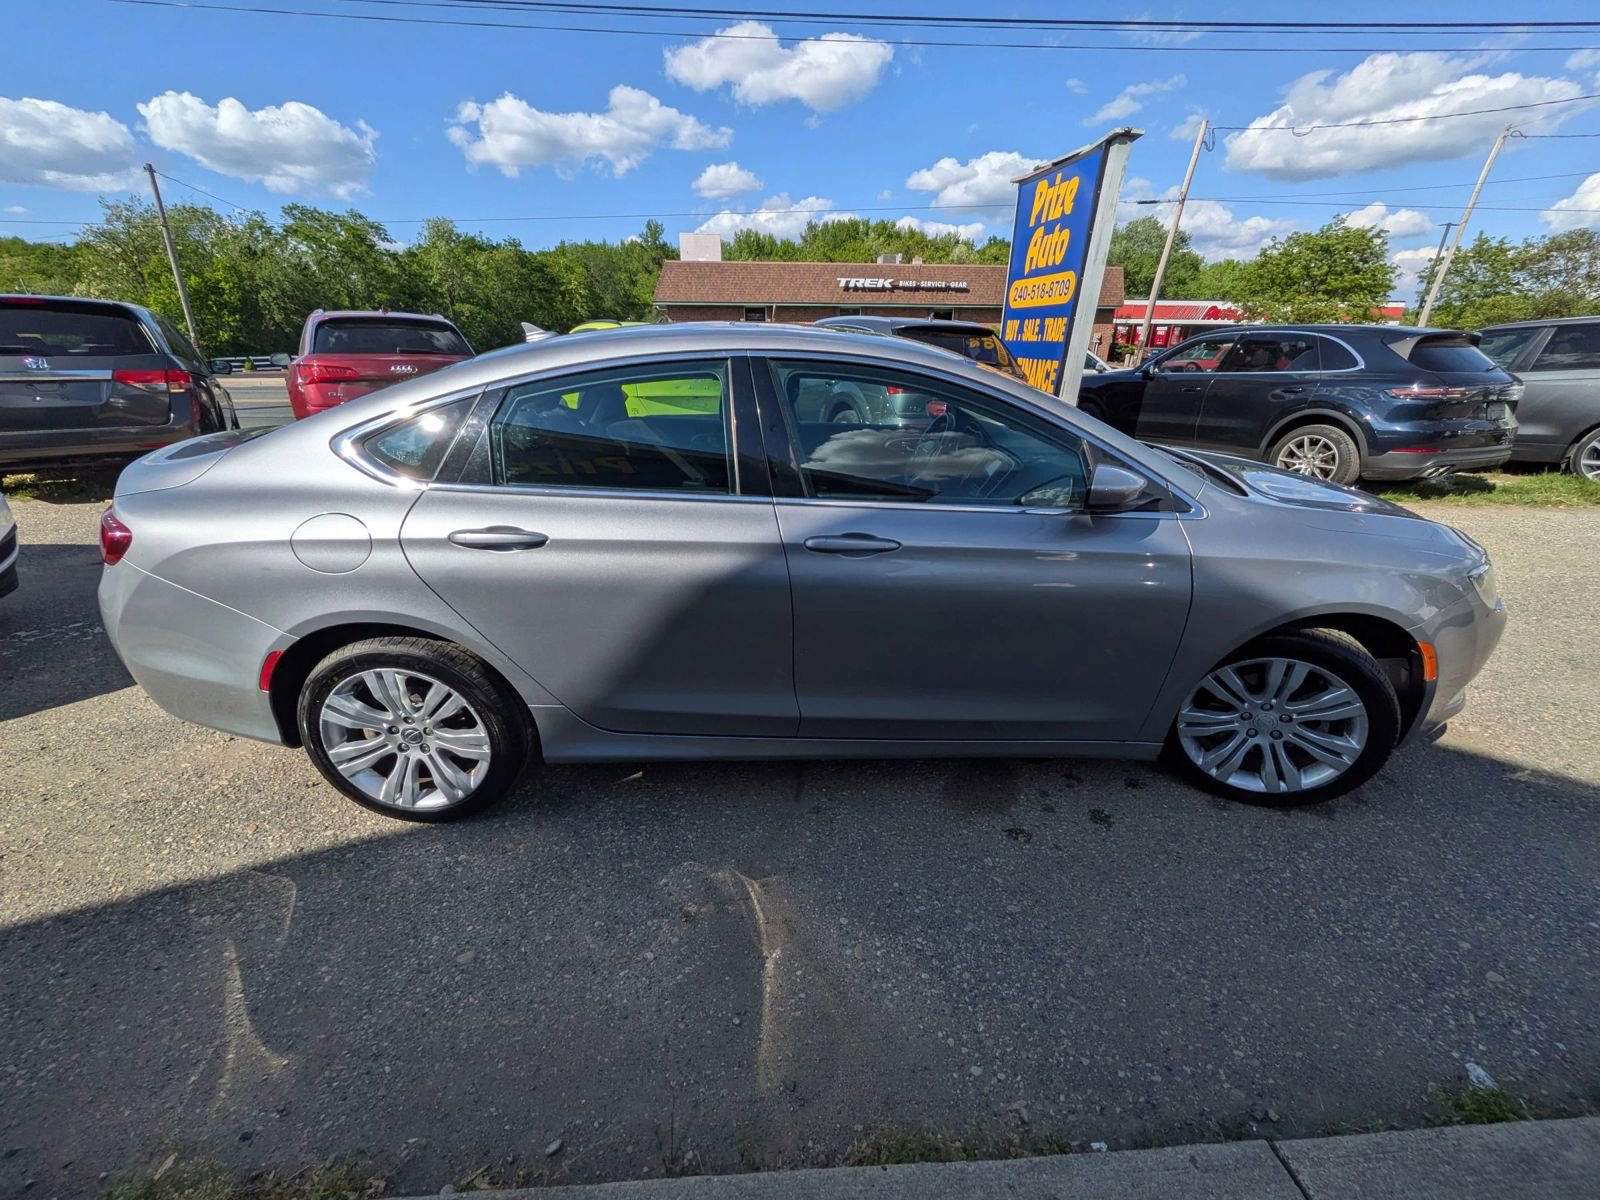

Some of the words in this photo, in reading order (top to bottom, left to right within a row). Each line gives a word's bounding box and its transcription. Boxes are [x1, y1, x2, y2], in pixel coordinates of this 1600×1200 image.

[1028, 172, 1080, 228] Prize
[1024, 223, 1071, 276] Auto
[836, 277, 894, 289] TREK
[899, 279, 916, 288] BIKES
[920, 280, 946, 289] SERVICE
[950, 281, 968, 289] GEAR
[1013, 278, 1071, 302] 240-518-8709
[1005, 319, 1020, 342] BUY
[1022, 318, 1041, 342] SALE
[1043, 316, 1068, 342] TRADE
